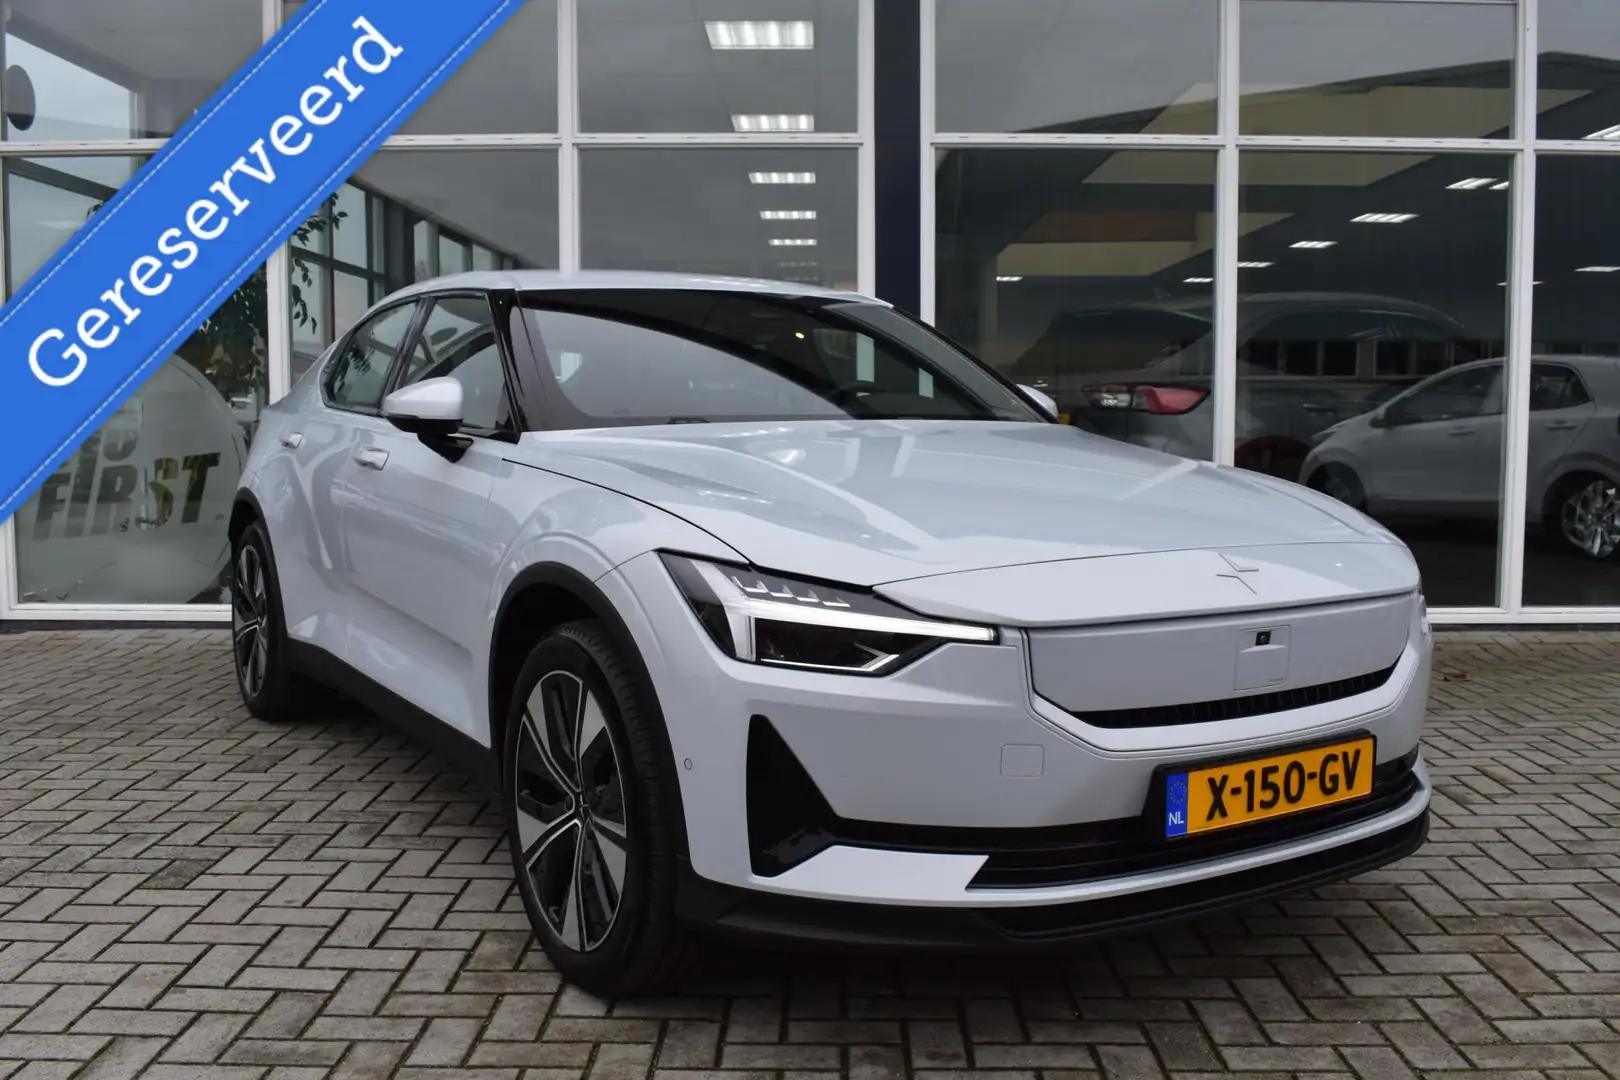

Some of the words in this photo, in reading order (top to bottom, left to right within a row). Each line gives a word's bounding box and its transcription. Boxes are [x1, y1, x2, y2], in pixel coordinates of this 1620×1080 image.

[34, 453, 221, 541] FIRST
[1168, 811, 1185, 826] NL
[1206, 749, 1361, 821] X-150-GV
